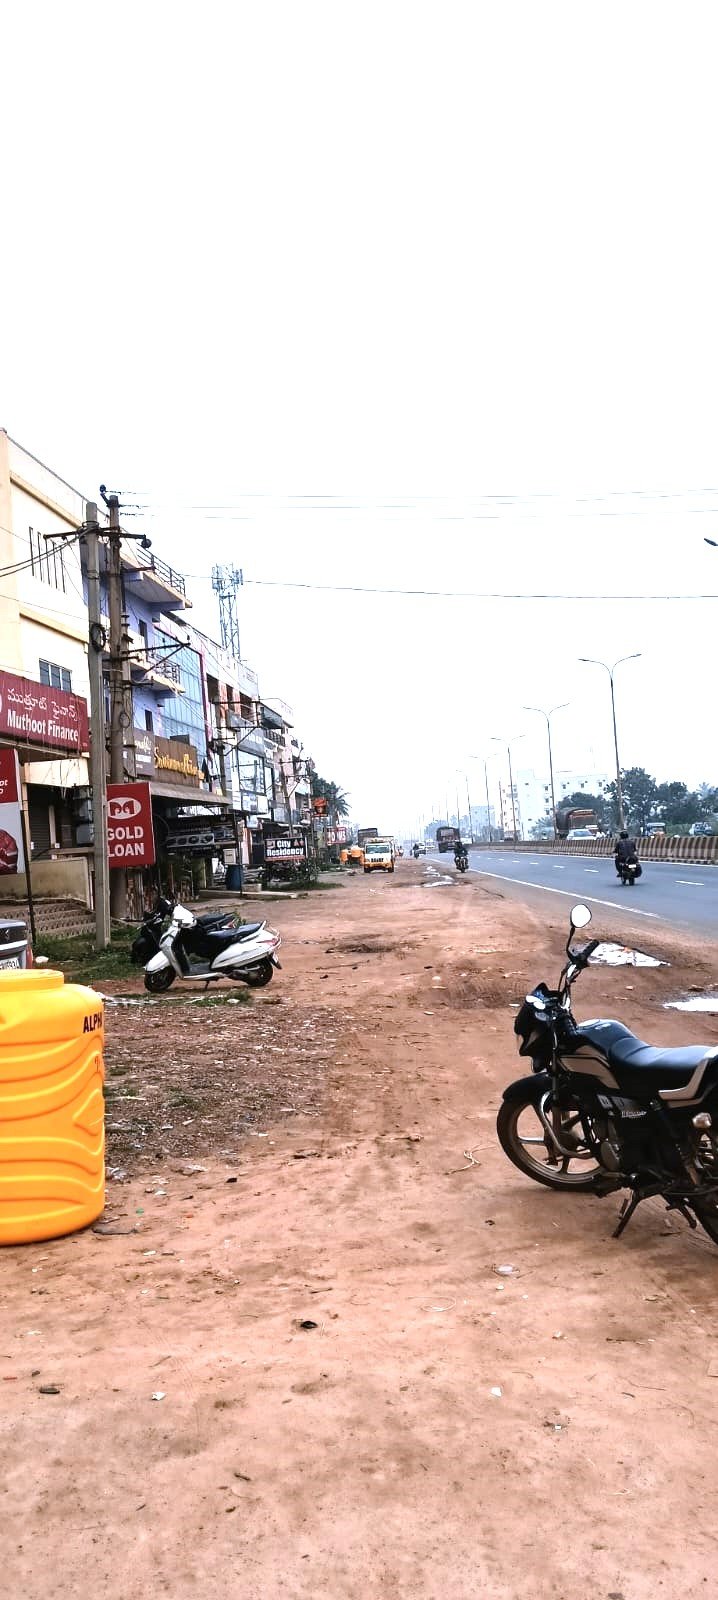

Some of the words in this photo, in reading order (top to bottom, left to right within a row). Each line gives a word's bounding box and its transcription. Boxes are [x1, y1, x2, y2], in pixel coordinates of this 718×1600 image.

[7, 708, 46, 735] Muthoot
[47, 719, 79, 742] Finance
[107, 826, 144, 841] GOLD
[107, 843, 145, 857] LOAN
[276, 840, 291, 848] City
